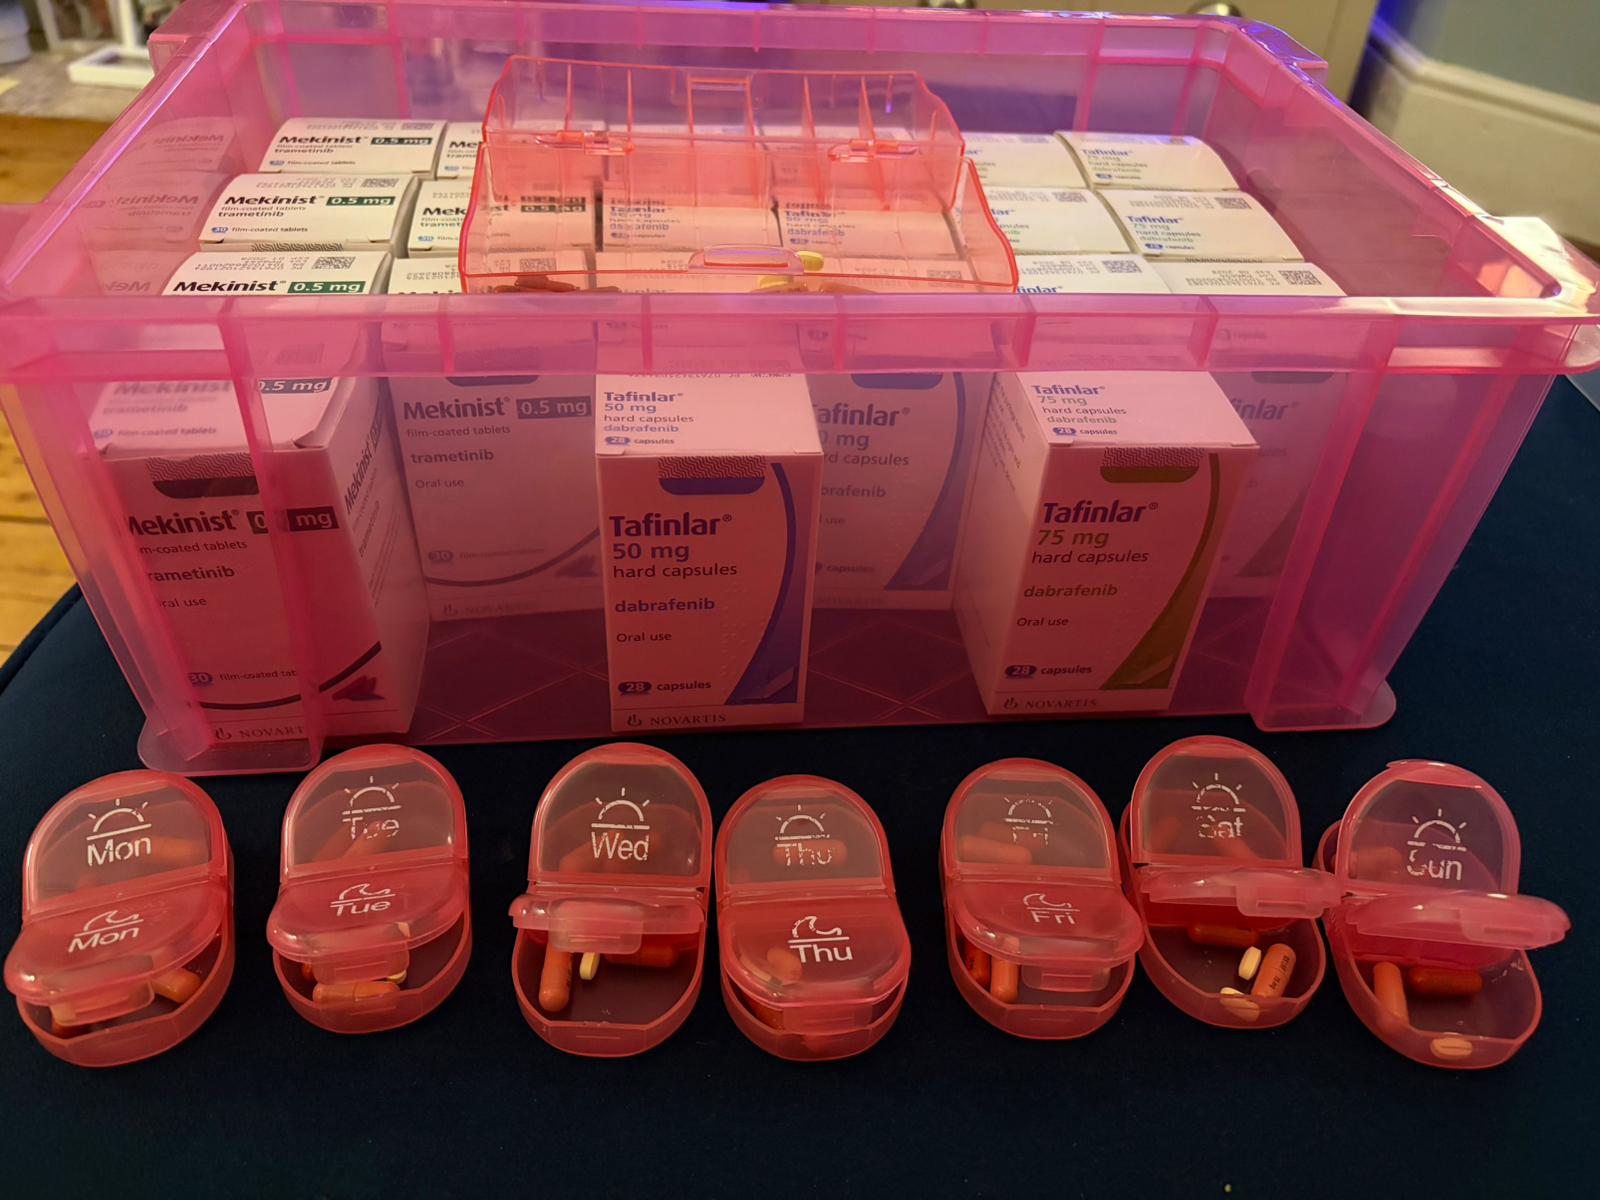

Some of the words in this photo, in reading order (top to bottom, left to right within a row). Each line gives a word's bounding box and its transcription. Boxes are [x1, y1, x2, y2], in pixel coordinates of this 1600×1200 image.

[331, 197, 358, 205] 0.5
[362, 198, 392, 206] mg
[218, 210, 284, 218] trametinib
[294, 282, 324, 292] 0.5
[328, 283, 361, 293] mg
[292, 382, 328, 393] mg
[1039, 395, 1058, 404] 75
[1062, 396, 1088, 406] mg
[520, 400, 550, 416] 0.5
[556, 400, 588, 416] mg
[604, 402, 624, 412] 50
[630, 404, 657, 414] mg
[1042, 406, 1072, 415] hard
[1074, 406, 1127, 417] capsules
[604, 414, 635, 423] hard
[639, 415, 694, 424] capsules
[1046, 415, 1118, 424] dabrafenib
[180, 427, 217, 436] tablets
[406, 428, 470, 438] film-coated
[473, 425, 512, 436] tablets
[604, 424, 680, 433] dabrafenib
[1079, 428, 1118, 436] capsules
[633, 437, 675, 445] capsules
[836, 433, 870, 451] mg
[410, 449, 495, 464] trametinib
[844, 454, 910, 467] capsules
[415, 480, 442, 490] Oral
[445, 478, 464, 488] use
[820, 484, 887, 498] brafenib
[296, 512, 332, 529] mg
[1037, 529, 1065, 546] 75
[1071, 530, 1110, 549] mg
[203, 540, 248, 552] tablets
[612, 542, 642, 560] 50
[651, 544, 690, 563] mg
[1031, 550, 1072, 564] hard
[1076, 550, 1150, 566] capsules
[148, 565, 236, 583] rametinib
[613, 566, 656, 579] hard
[662, 563, 738, 580] capsules
[1023, 584, 1119, 598] dabrafenib
[184, 596, 208, 608] use
[615, 598, 716, 614] dabrafenib
[1016, 616, 1044, 628] Oral
[1048, 618, 1070, 627] use
[616, 632, 646, 643] Oral
[650, 632, 672, 642] use
[219, 670, 278, 682] film-coated
[1040, 664, 1093, 676] capsules
[656, 681, 712, 693] capsules
[1024, 697, 1098, 710] NOVARTIS
[650, 714, 726, 726] NOVARTIS
[240, 725, 305, 740] NOVART
[86, 836, 152, 868] Mon
[590, 830, 650, 862] Wed
[330, 900, 392, 917] Tue
[1030, 909, 1077, 926] Fri
[68, 926, 140, 954] Mon
[788, 943, 854, 964] Thu
